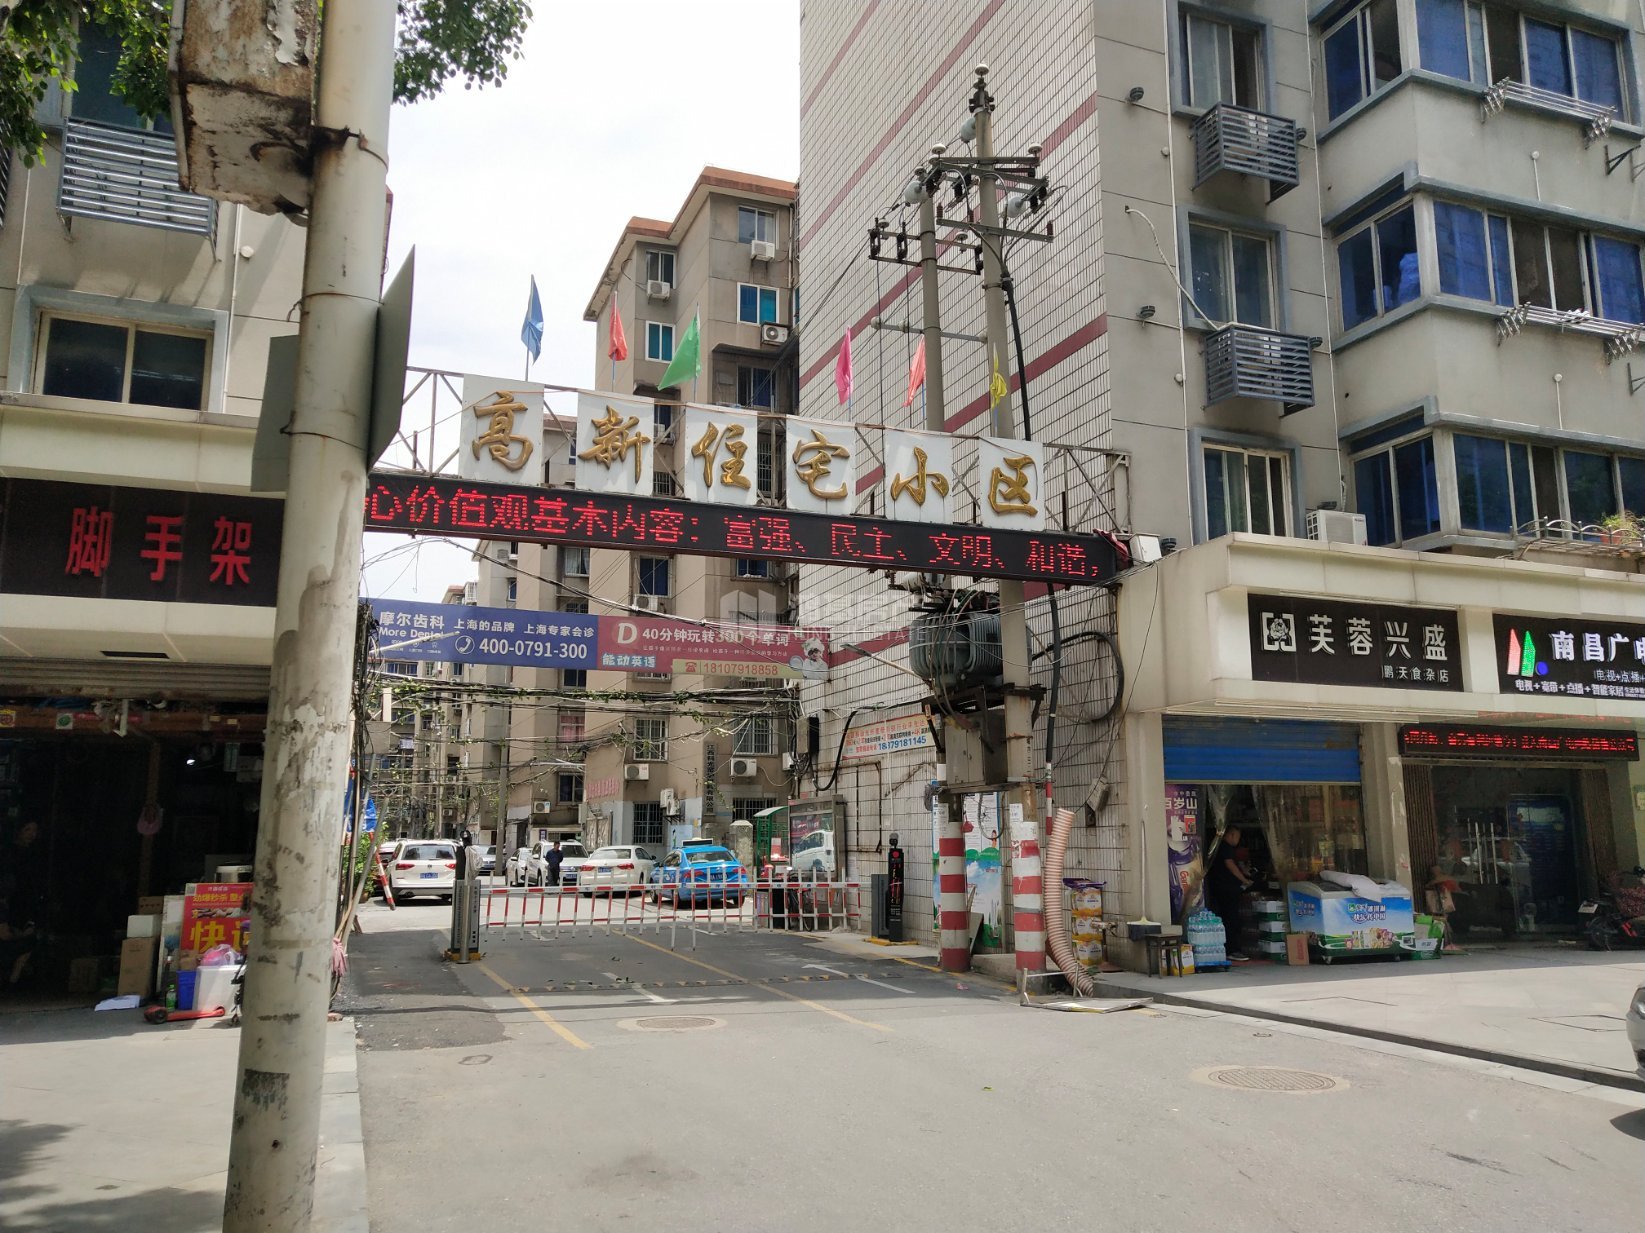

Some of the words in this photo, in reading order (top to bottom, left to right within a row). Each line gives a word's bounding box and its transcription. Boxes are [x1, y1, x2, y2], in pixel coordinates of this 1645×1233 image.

[472, 391, 1038, 516] 高新住宅小区
[65, 506, 252, 585] 脚手架
[379, 611, 445, 630] 摩尔齿科
[454, 618, 515, 633] 上海的品牌
[524, 623, 595, 637] 上海专家会诊
[378, 626, 407, 638] More
[1307, 613, 1448, 661] 芙蓉兴盛
[479, 638, 588, 659] 400-0791-300
[602, 653, 656, 668] 能动英语
[704, 662, 778, 676] 18107918858
[1383, 664, 1449, 683] 鹏天食杂店
